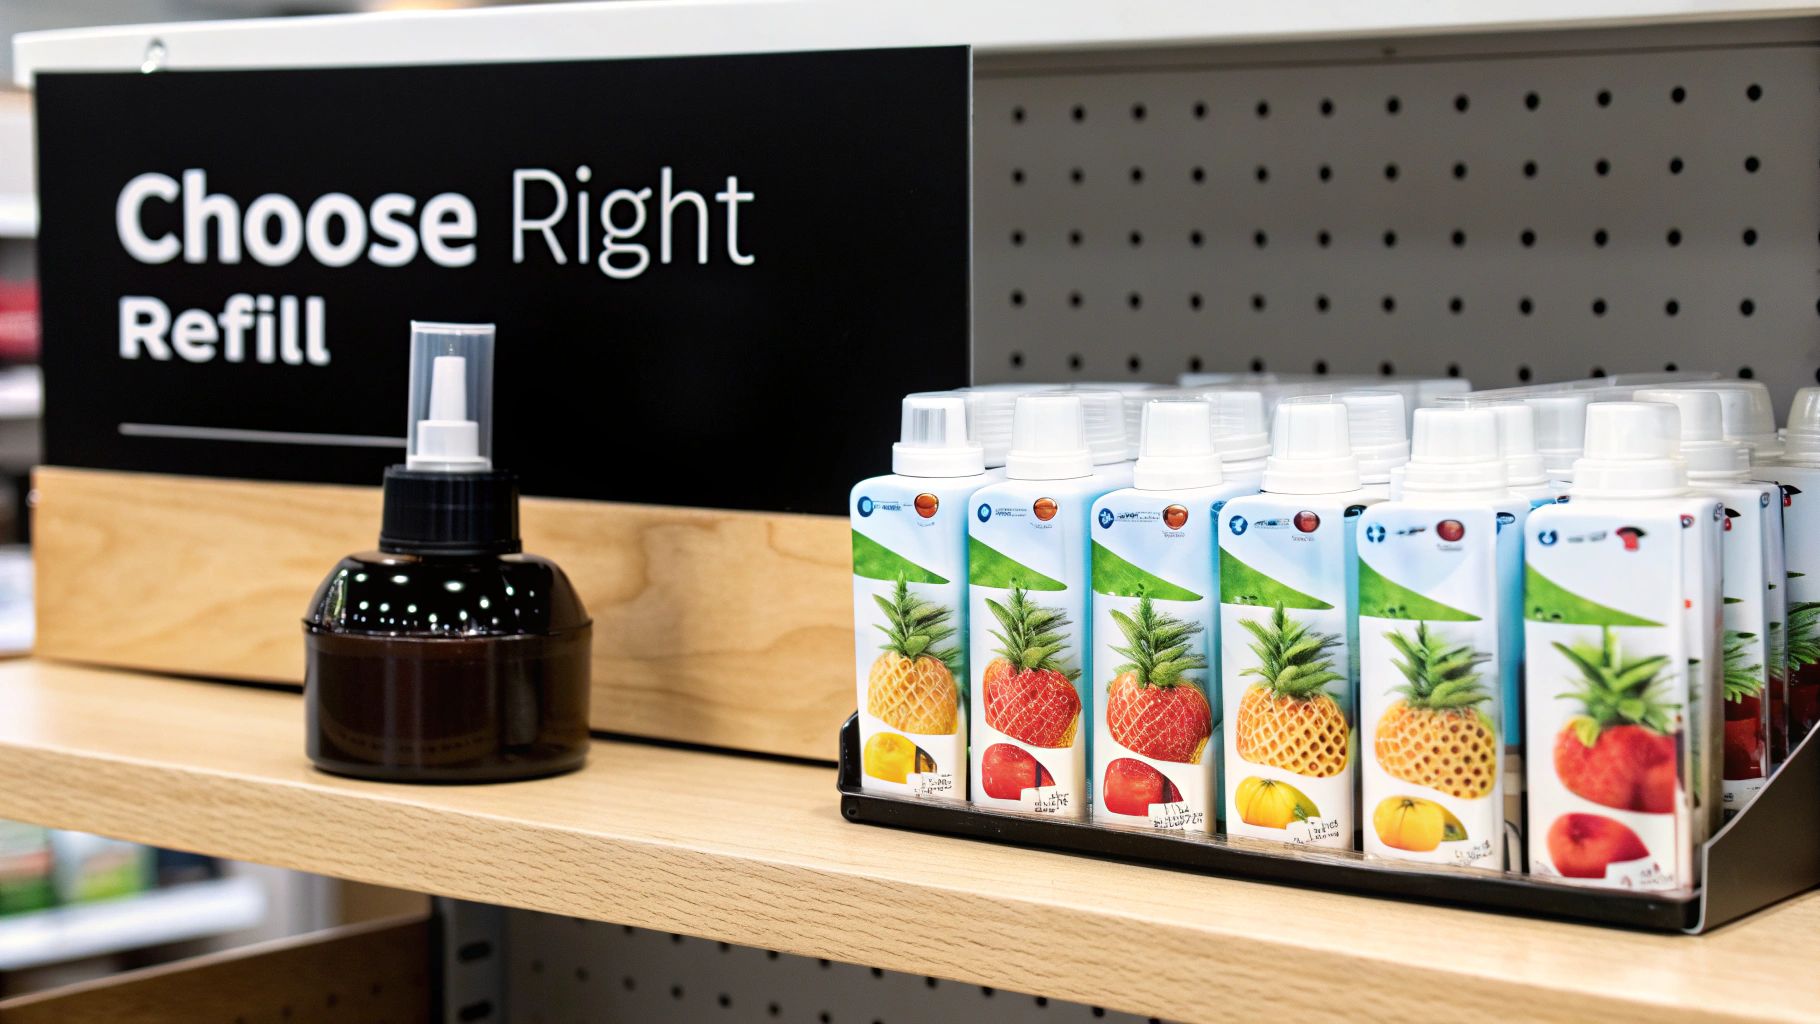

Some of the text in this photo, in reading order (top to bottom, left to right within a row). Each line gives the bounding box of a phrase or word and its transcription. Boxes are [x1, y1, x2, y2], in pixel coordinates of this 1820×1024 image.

[117, 166, 755, 279] Choose Right
[119, 294, 330, 365] Refill
